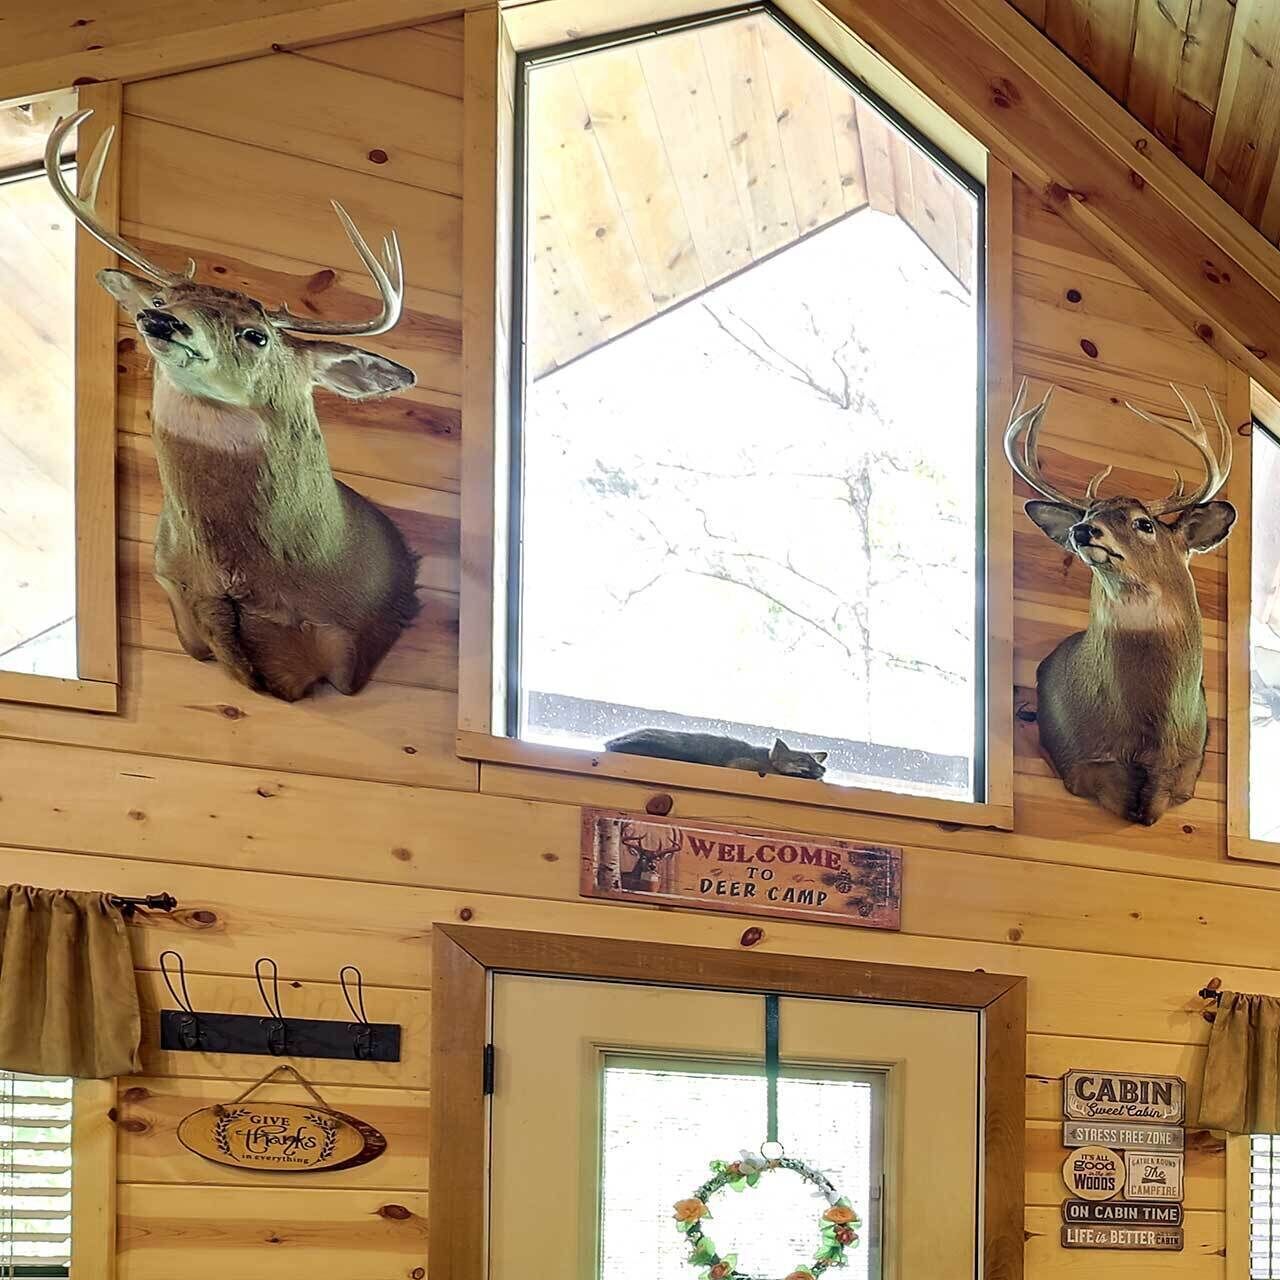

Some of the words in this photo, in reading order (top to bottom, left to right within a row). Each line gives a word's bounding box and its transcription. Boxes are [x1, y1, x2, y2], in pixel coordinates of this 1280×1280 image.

[687, 835, 842, 871] WELCOME
[746, 866, 774, 881] TO
[699, 878, 757, 898] DEER
[767, 886, 828, 907] CAMP
[1074, 1076, 1174, 1106] CABIN
[1086, 1102, 1125, 1117] Sweet
[1125, 1104, 1162, 1118] Cabin
[250, 1115, 290, 1126] GIVE
[236, 1124, 317, 1156] thanks
[1076, 1127, 1117, 1143] STRESS
[1120, 1129, 1145, 1144] FREE
[1146, 1131, 1172, 1145] ZONE
[254, 1155, 310, 1164] everything
[1073, 1160, 1116, 1172] good
[1143, 1165, 1166, 1179] The
[1073, 1173, 1116, 1191] WOODS
[1131, 1184, 1177, 1196] CAMPFIRE
[1070, 1205, 1089, 1218] ON
[1094, 1205, 1138, 1220] CABIN
[1142, 1207, 1178, 1221] TIME
[1067, 1228, 1094, 1243] LIFE
[1095, 1231, 1108, 1244] is
[1110, 1229, 1155, 1245] BETTER
